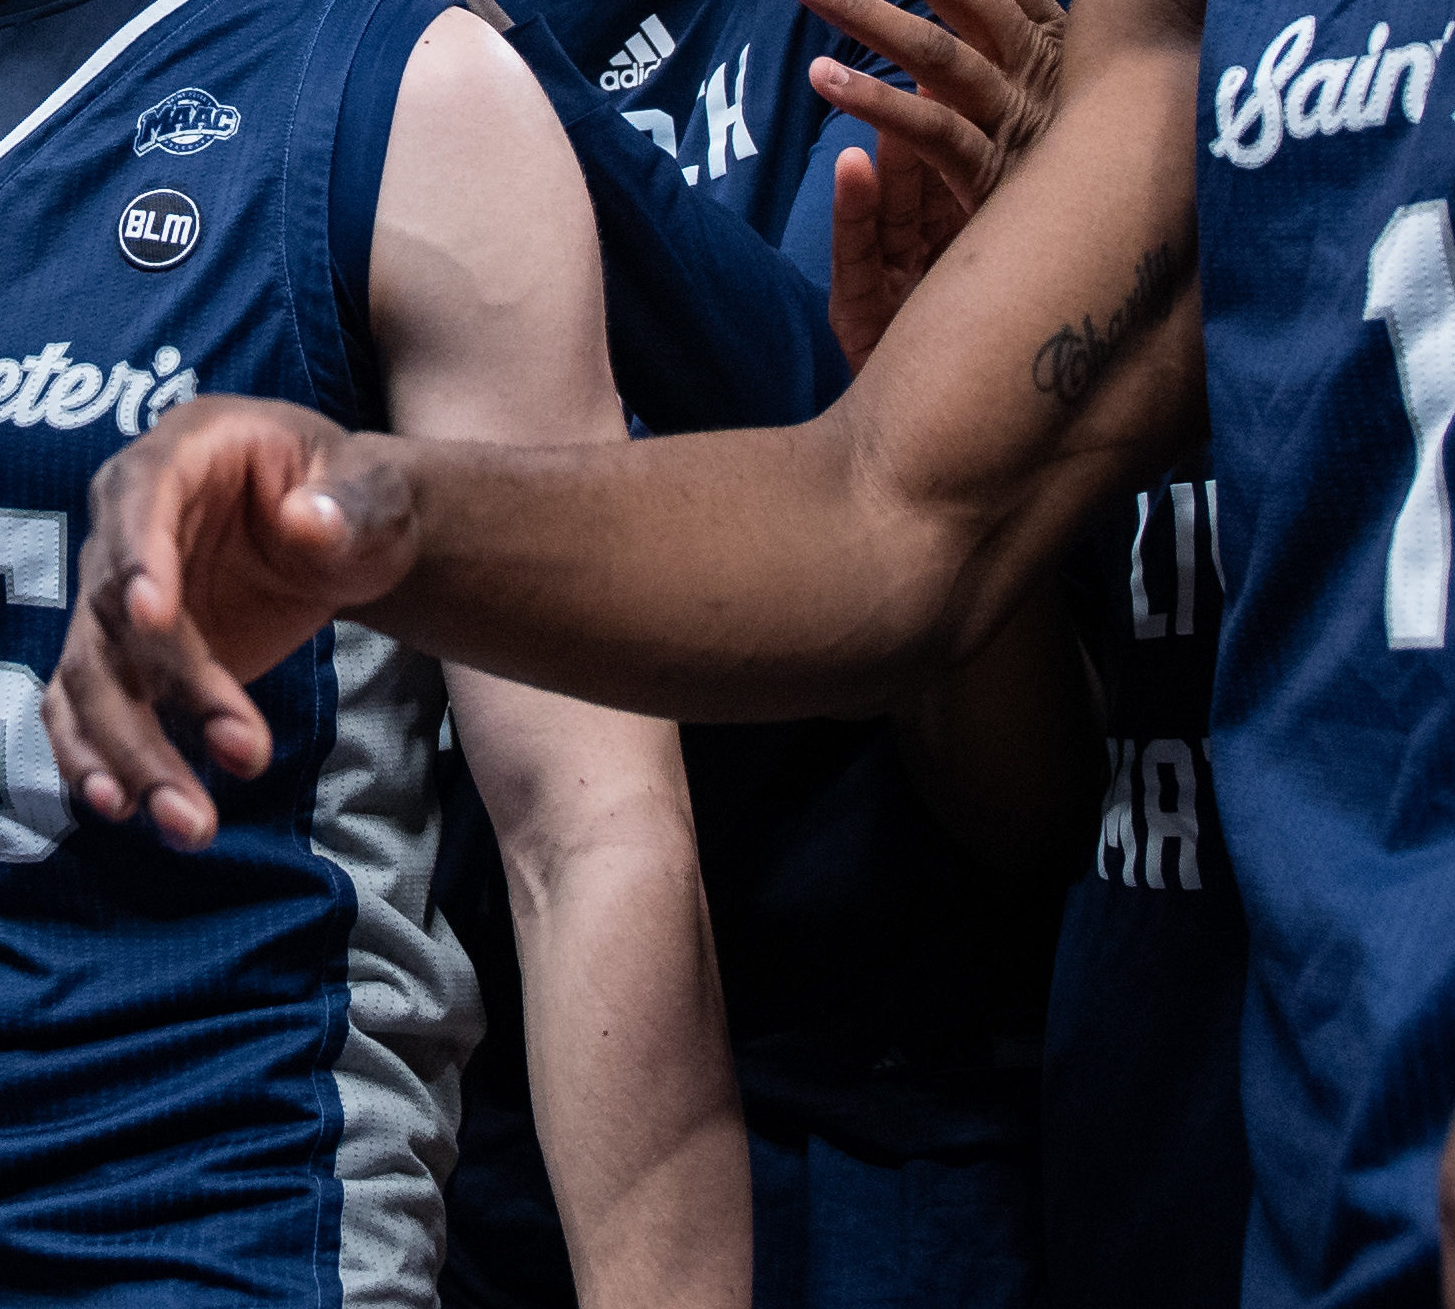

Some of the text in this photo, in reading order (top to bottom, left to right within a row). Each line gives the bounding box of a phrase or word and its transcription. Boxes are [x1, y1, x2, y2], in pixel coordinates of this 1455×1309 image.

[136, 104, 239, 153] MAAC
[124, 208, 193, 244] BLM
[1097, 737, 1216, 891] MA
